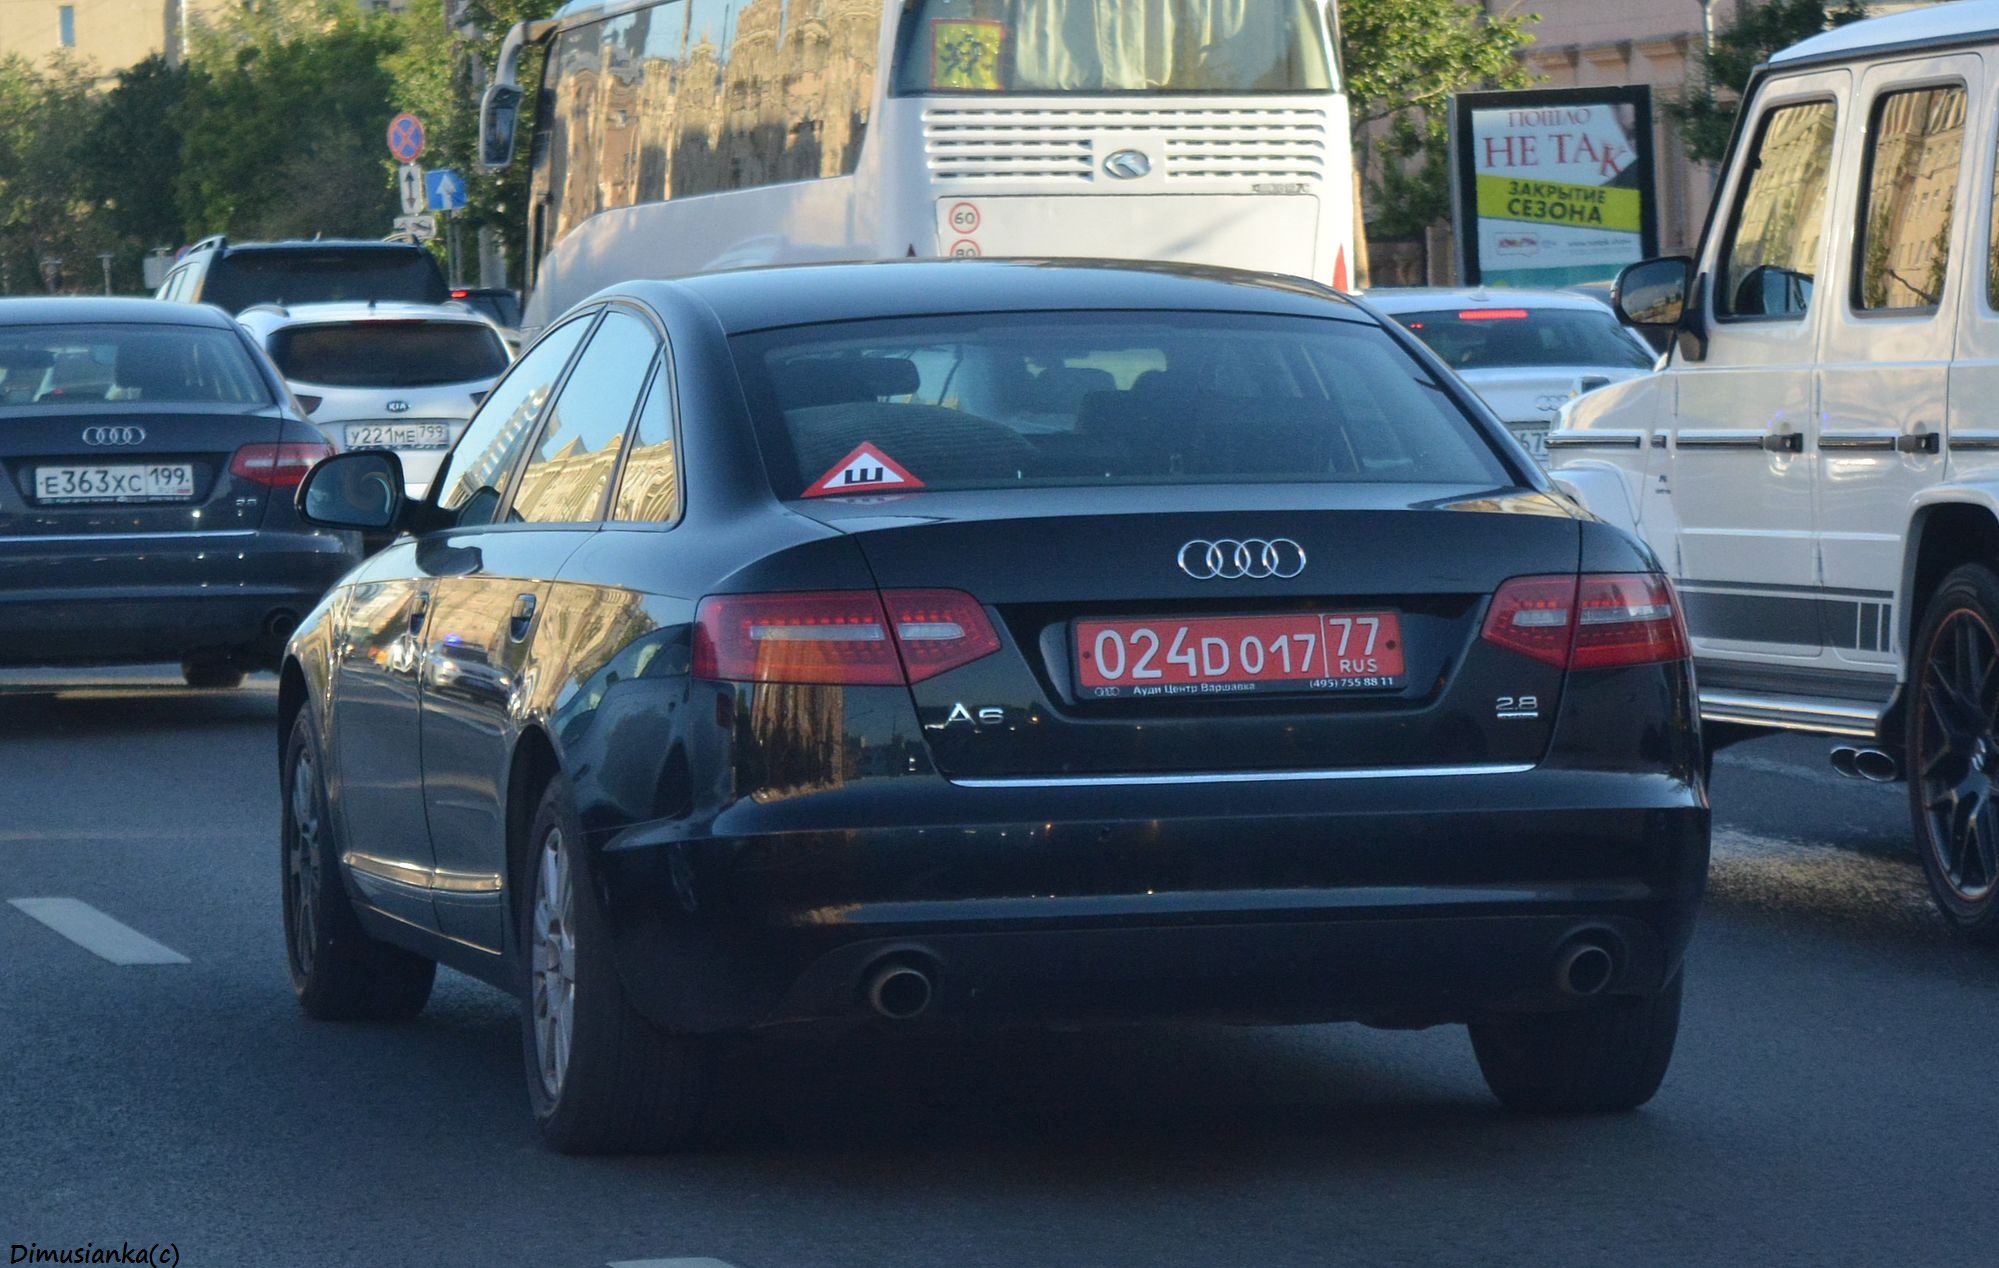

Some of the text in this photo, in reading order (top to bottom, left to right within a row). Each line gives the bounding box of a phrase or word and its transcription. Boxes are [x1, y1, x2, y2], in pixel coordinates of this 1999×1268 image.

[1508, 108, 1591, 127] ПОШЛО
[1482, 133, 1628, 178] НЕ ТАК
[1507, 181, 1607, 204] ЗАКРЫТИЕ
[954, 211, 976, 225] 60
[1507, 198, 1602, 224] СЕЗОНА
[388, 402, 408, 411] KIA
[418, 425, 443, 438] 799
[149, 467, 185, 486] 199
[844, 467, 884, 485] Ш
[1329, 617, 1381, 657] 77
[1339, 658, 1379, 673] RUS
[1133, 676, 1394, 696] Ауди Центр Варшавка (495) 755 88 11
[1495, 696, 1538, 711] 2.8
[944, 702, 1005, 725] A6
